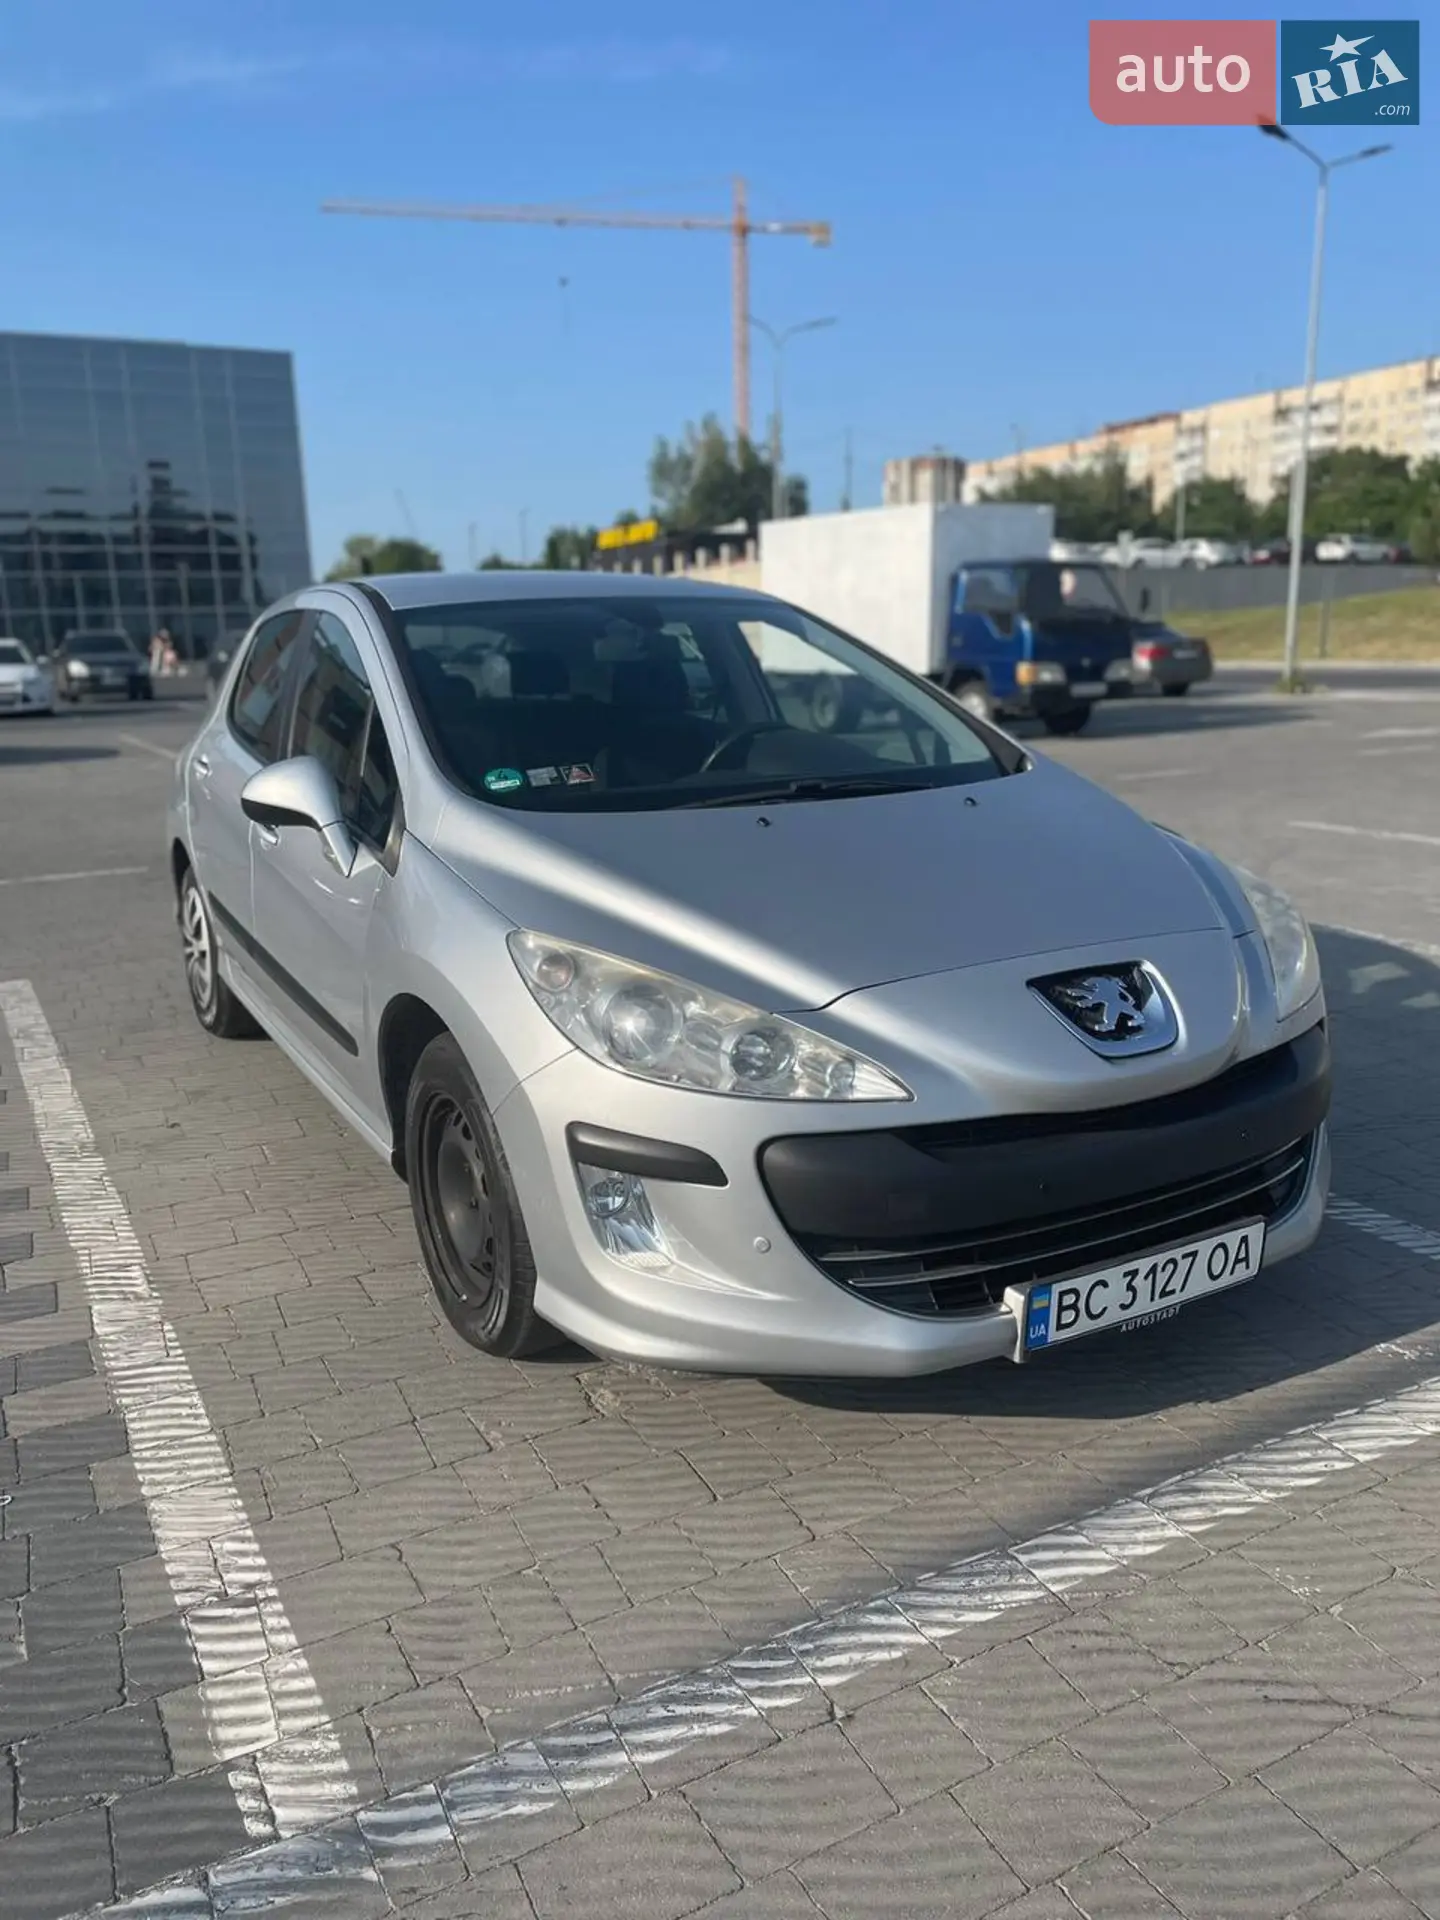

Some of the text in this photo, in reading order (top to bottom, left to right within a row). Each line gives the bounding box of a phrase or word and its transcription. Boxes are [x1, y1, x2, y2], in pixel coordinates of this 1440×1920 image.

[1055, 1235, 1250, 1331] BC 3127 OA
[1030, 1323, 1046, 1338] UA
